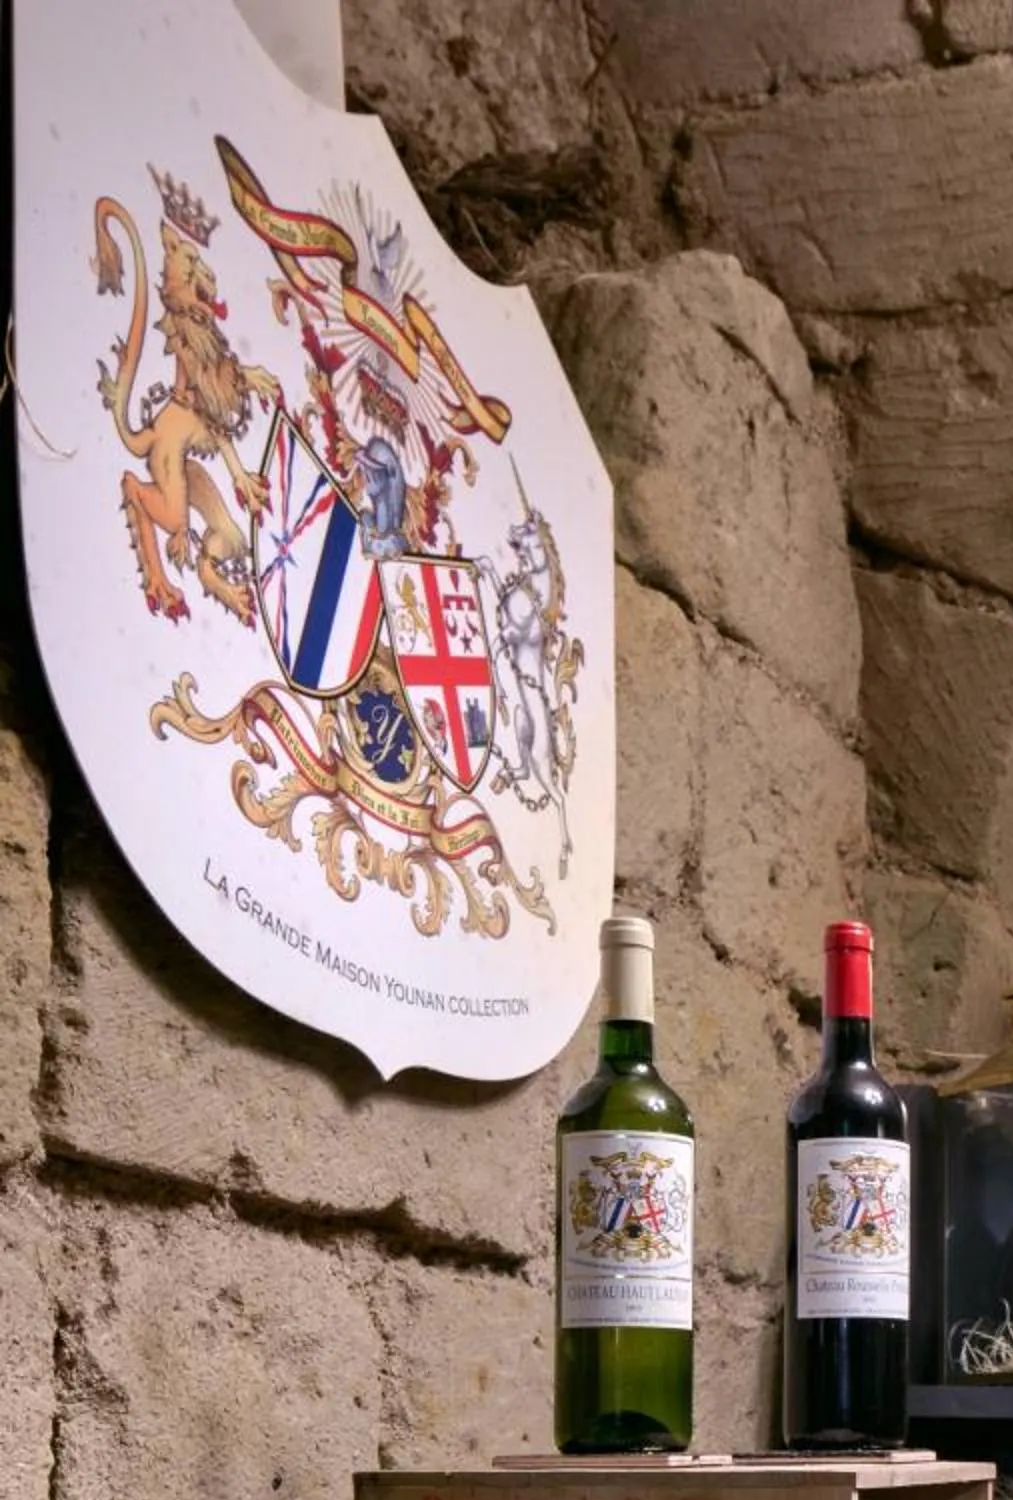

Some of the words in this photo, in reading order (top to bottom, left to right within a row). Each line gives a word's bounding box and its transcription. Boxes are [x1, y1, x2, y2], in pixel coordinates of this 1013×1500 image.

[202, 857, 229, 899] LA
[235, 886, 312, 957] GRANDE
[315, 940, 381, 993] MAISON
[384, 975, 445, 1011] YOUNAN
[449, 996, 529, 1018] COLLECTION
